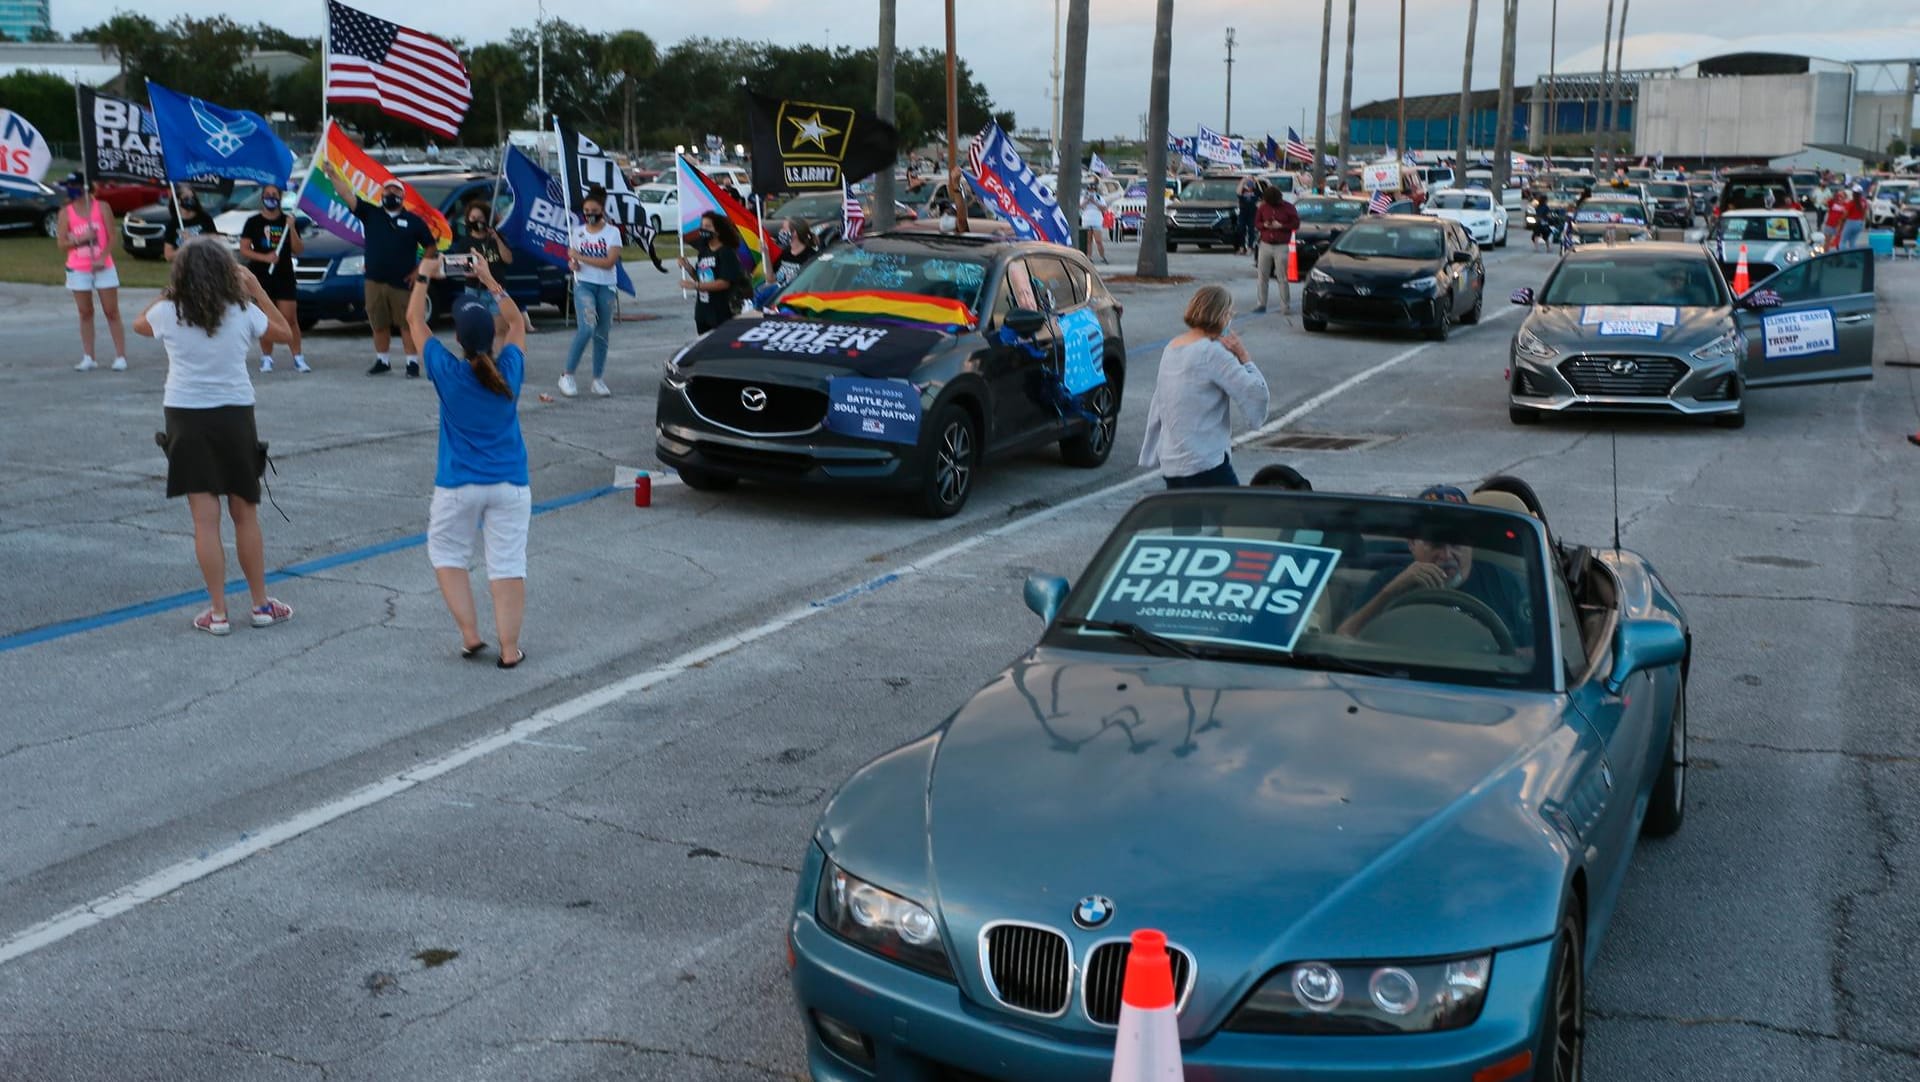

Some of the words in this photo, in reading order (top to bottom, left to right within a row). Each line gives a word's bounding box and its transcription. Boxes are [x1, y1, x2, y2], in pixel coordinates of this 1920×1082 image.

[98, 159, 121, 172] OF
[127, 162, 166, 180] THIS
[342, 160, 381, 200] LOV
[1766, 317, 1796, 326] CLIMATE
[1800, 312, 1829, 321] CHANGE
[737, 326, 880, 351] BIDEN
[762, 341, 827, 354] 2020
[1768, 335, 1799, 346] TRUMP
[1806, 339, 1830, 349] HOAX
[846, 394, 882, 407] BATTLE
[882, 398, 893, 408] for
[894, 400, 906, 409] the
[833, 402, 858, 414] SOUL
[881, 409, 916, 422] NATION
[1127, 547, 1320, 587] BIDEN
[1111, 578, 1303, 615] HARRIS
[1136, 606, 1253, 623] JOEBIDEN.COM
